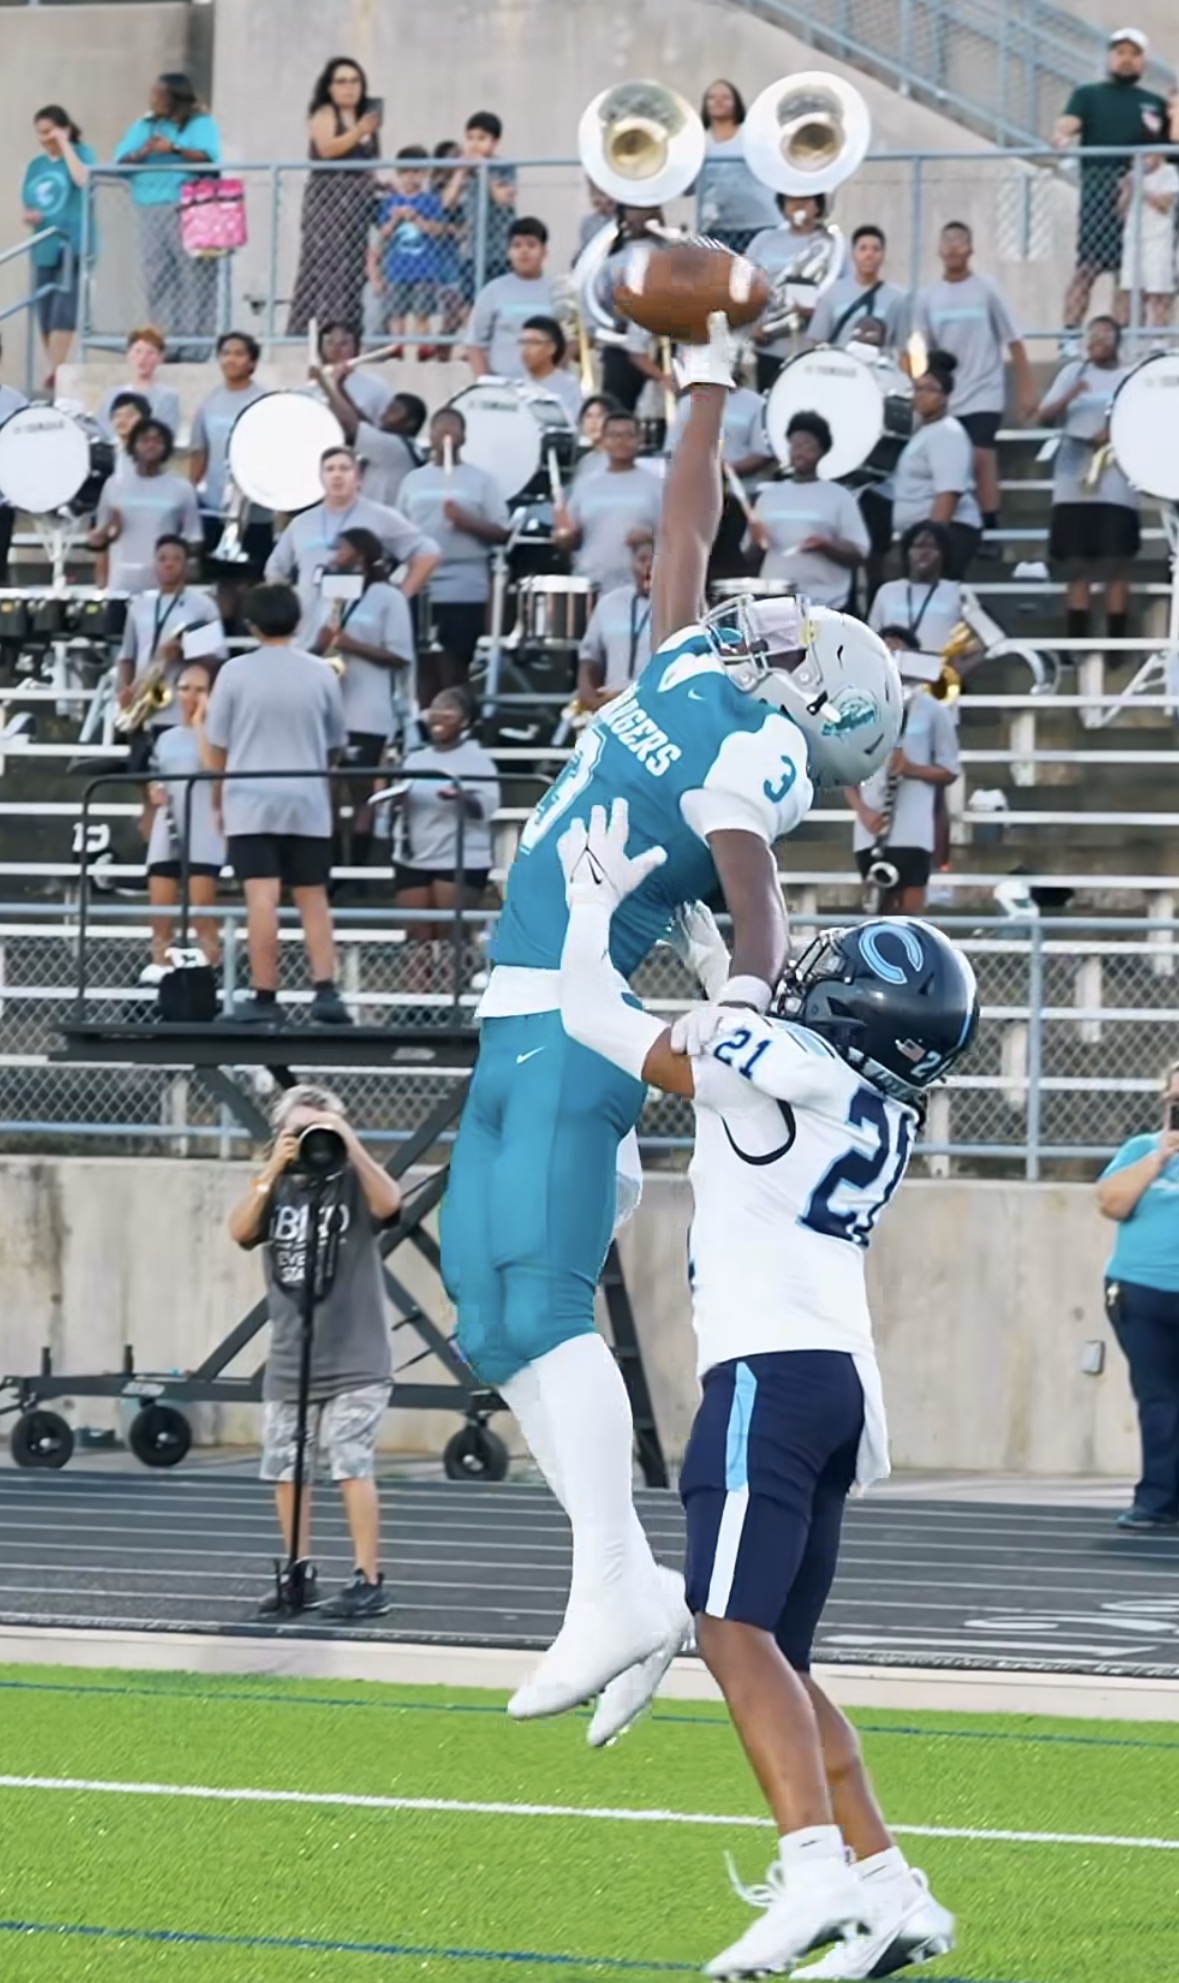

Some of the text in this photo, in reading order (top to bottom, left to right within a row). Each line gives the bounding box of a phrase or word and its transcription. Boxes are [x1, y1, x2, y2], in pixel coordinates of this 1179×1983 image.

[763, 755, 796, 803] 3
[859, 924, 923, 985] C
[713, 1029, 773, 1081] 21
